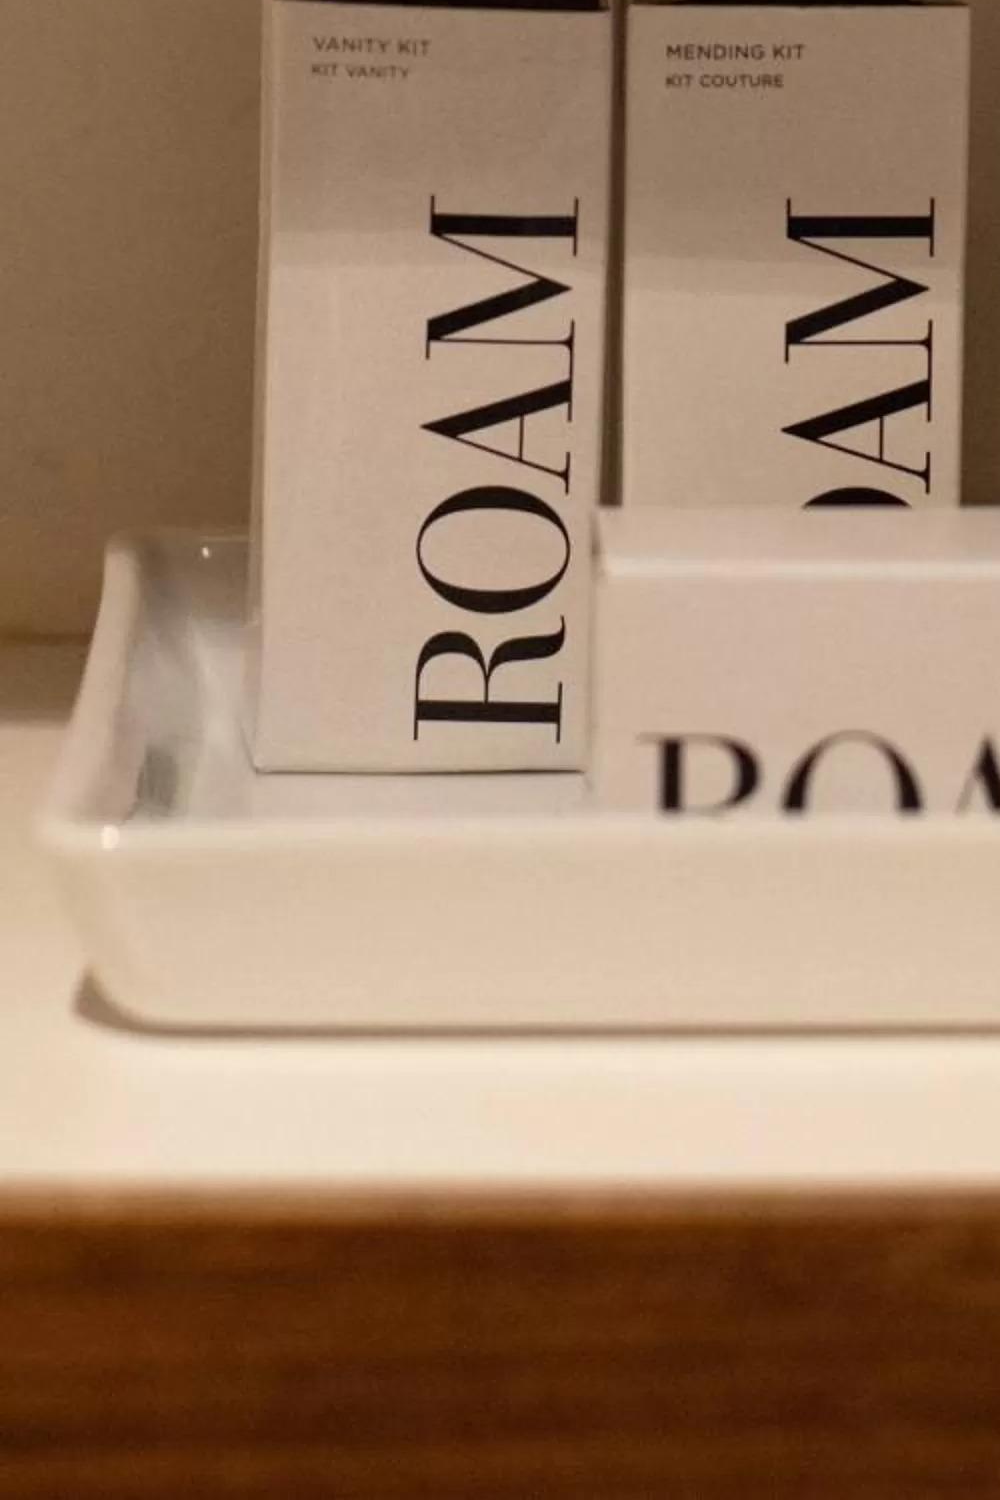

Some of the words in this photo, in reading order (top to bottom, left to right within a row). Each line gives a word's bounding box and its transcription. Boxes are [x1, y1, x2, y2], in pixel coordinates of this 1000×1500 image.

[311, 36, 390, 54] VANITY
[397, 39, 432, 56] KIT
[665, 44, 766, 60] MENDING
[772, 44, 806, 60] KIT
[310, 63, 341, 78] KIT
[345, 64, 410, 80] VANITY
[664, 74, 692, 89] KIT
[699, 73, 784, 89] COUTURE
[413, 194, 579, 744] ROAM
